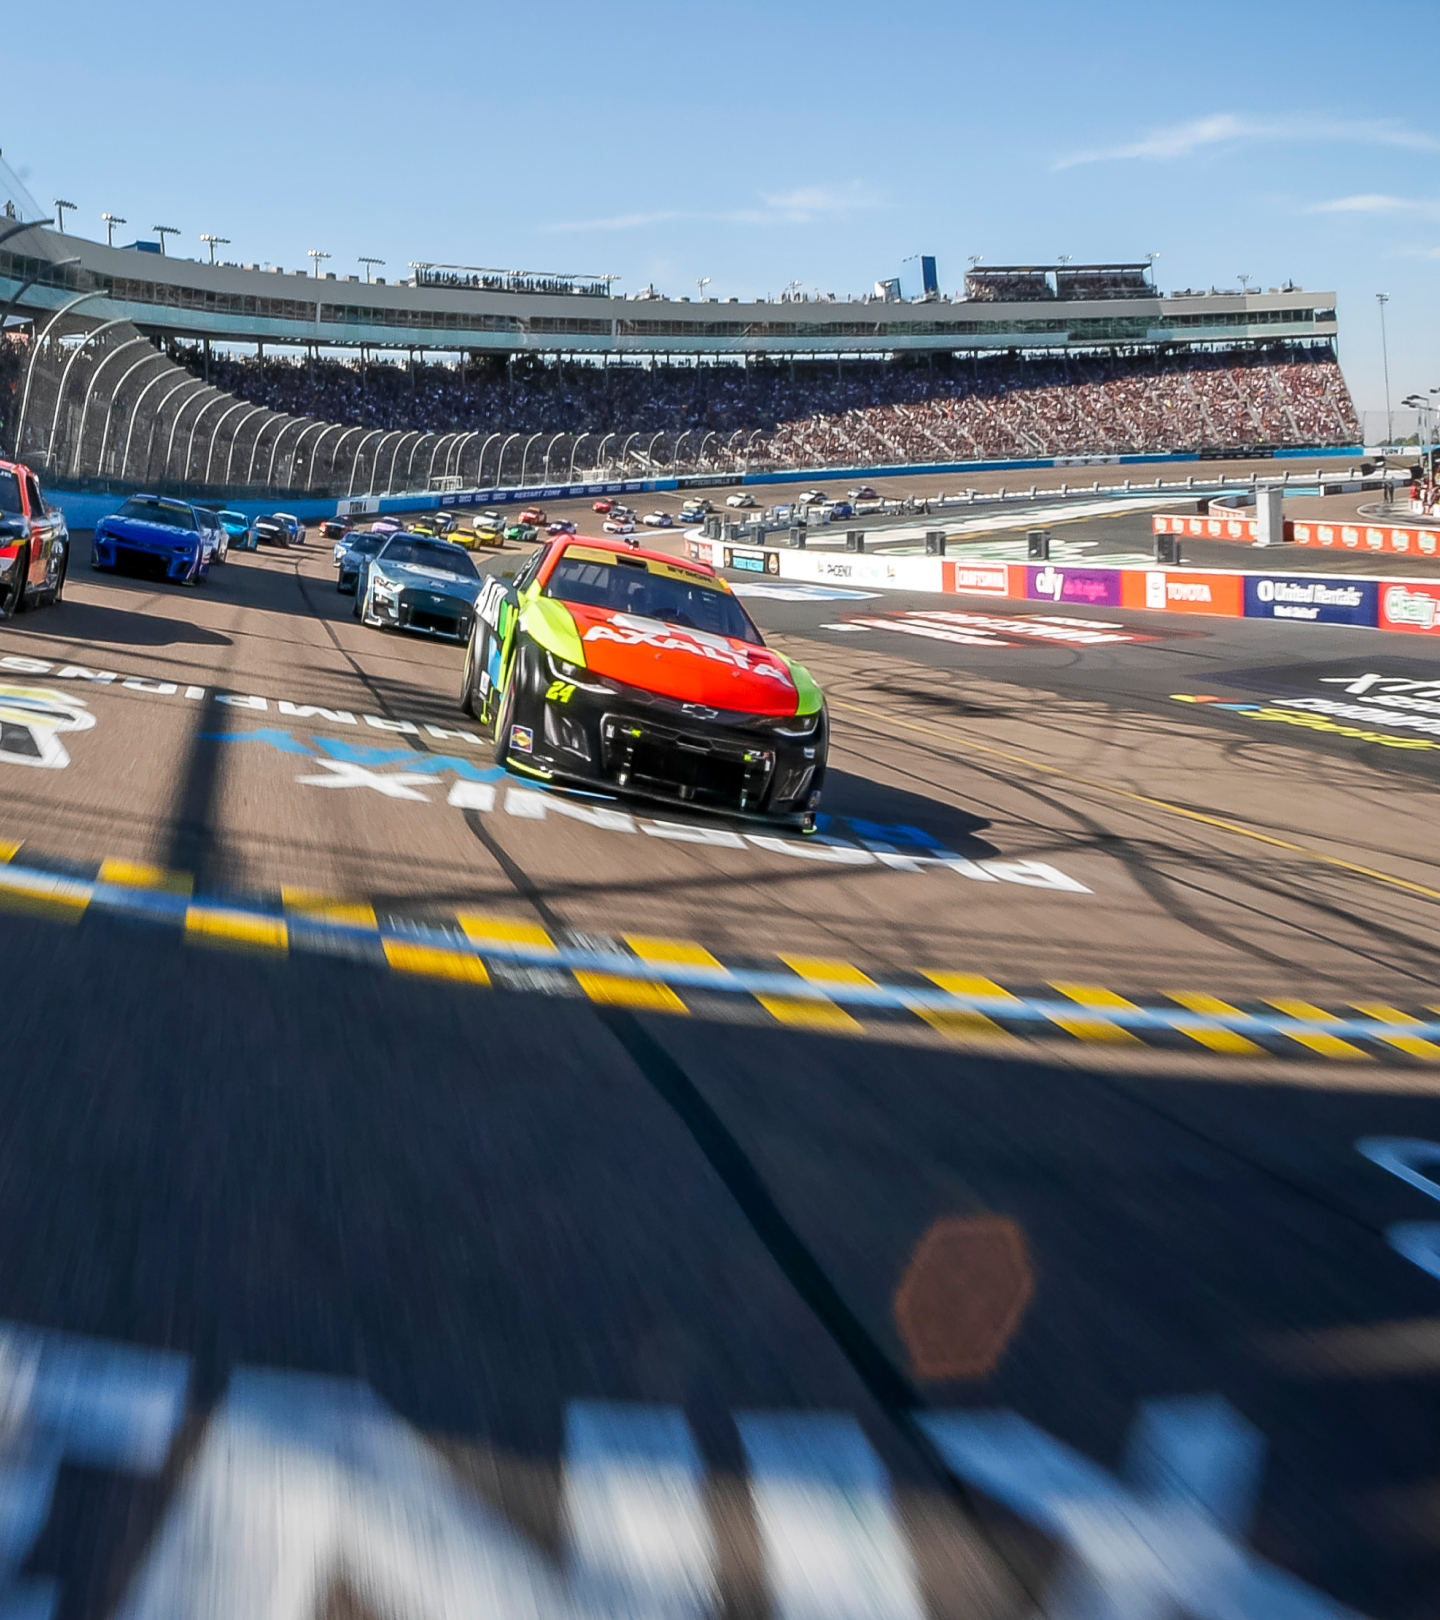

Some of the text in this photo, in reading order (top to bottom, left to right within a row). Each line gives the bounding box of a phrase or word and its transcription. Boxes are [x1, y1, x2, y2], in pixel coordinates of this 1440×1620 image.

[513, 490, 541, 499] RESTART
[1035, 566, 1064, 601] ally
[1166, 582, 1212, 602] TOYOTA
[1274, 582, 1363, 607] United Rentals
[583, 625, 796, 688] AXALTA
[545, 681, 577, 704] 24
[294, 756, 1096, 895] PHOENIX
